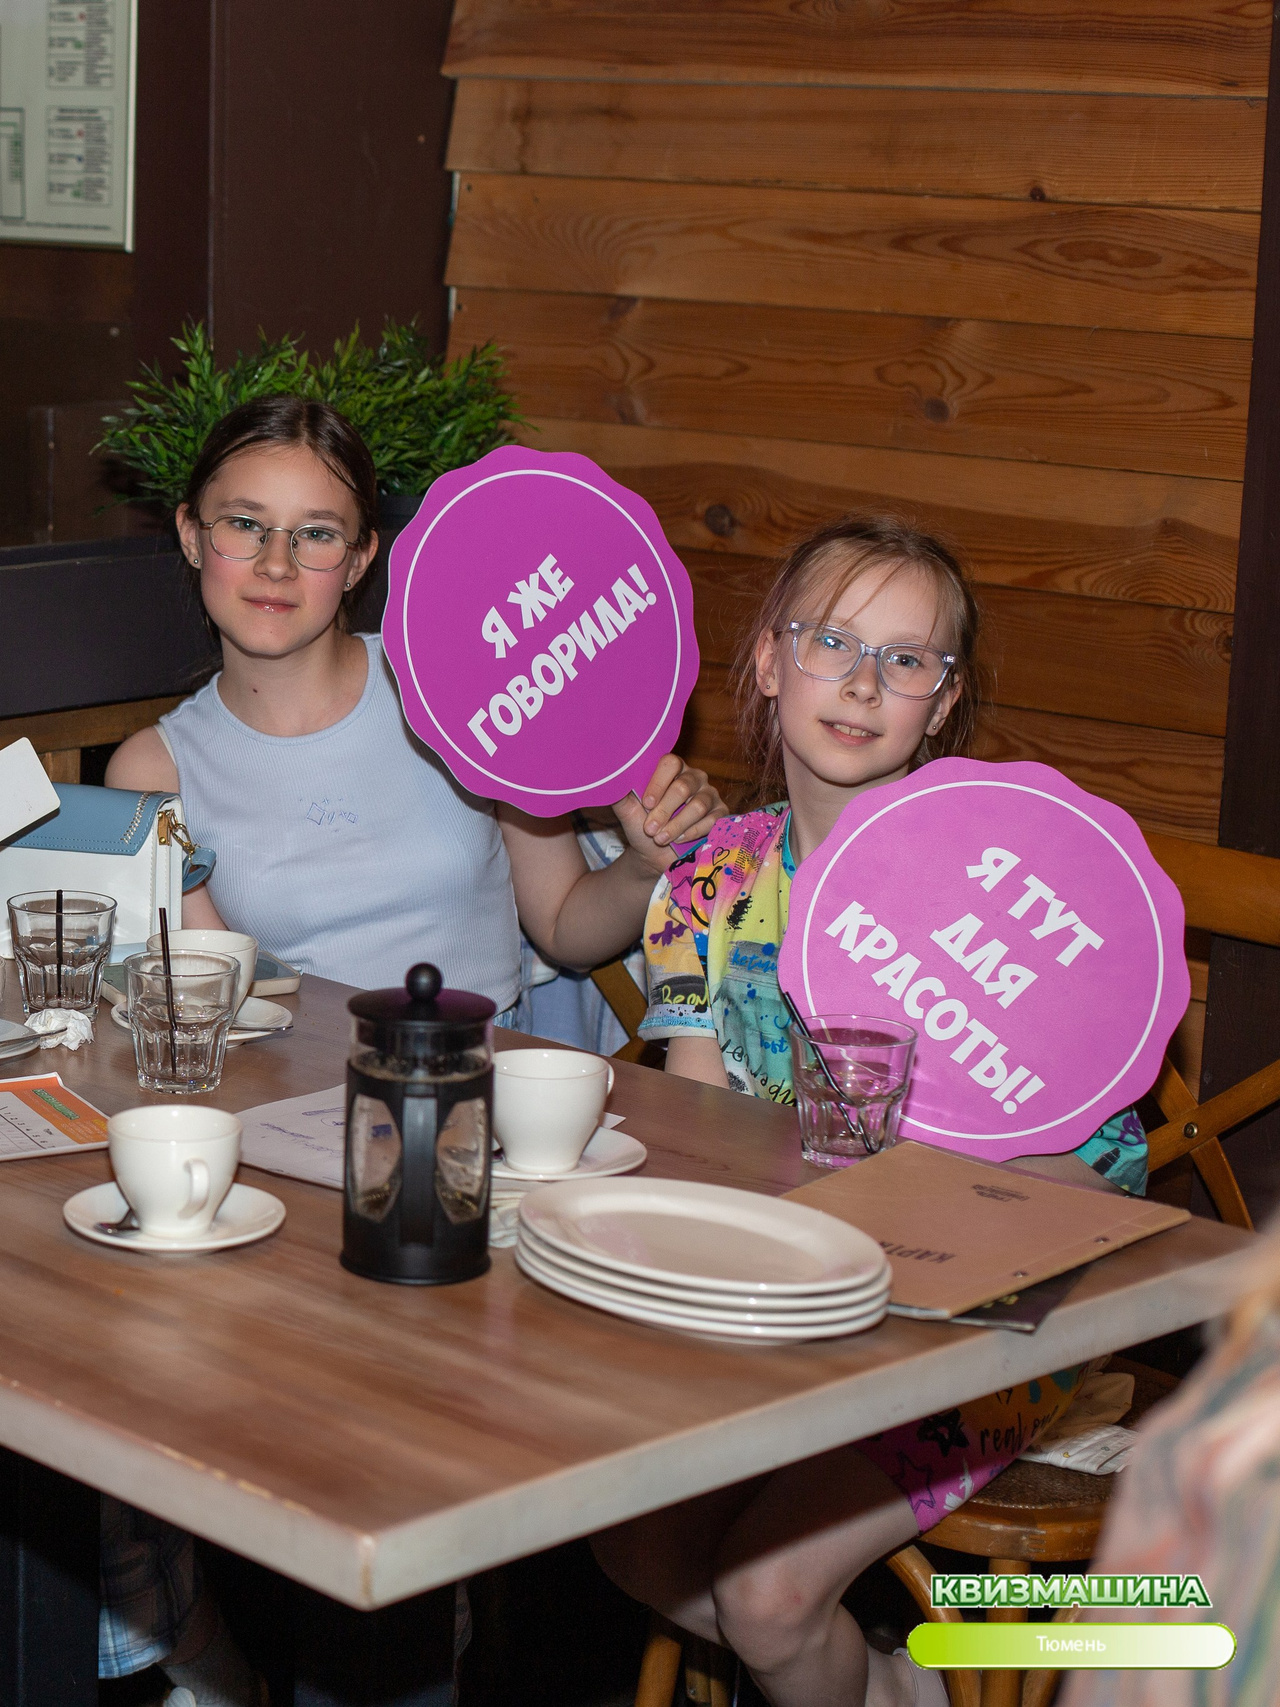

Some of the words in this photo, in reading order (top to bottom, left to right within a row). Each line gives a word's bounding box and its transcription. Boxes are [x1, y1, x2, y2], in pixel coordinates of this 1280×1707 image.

[467, 563, 657, 757] ГОВОРИЛА!
[481, 605, 519, 659] Я
[507, 553, 575, 629] ЖЕ
[929, 912, 1039, 1010] ДЛЯ
[966, 846, 1021, 893] Я
[1007, 873, 1105, 968] ТУТ
[824, 900, 1046, 1115] КРАСОТЫ!
